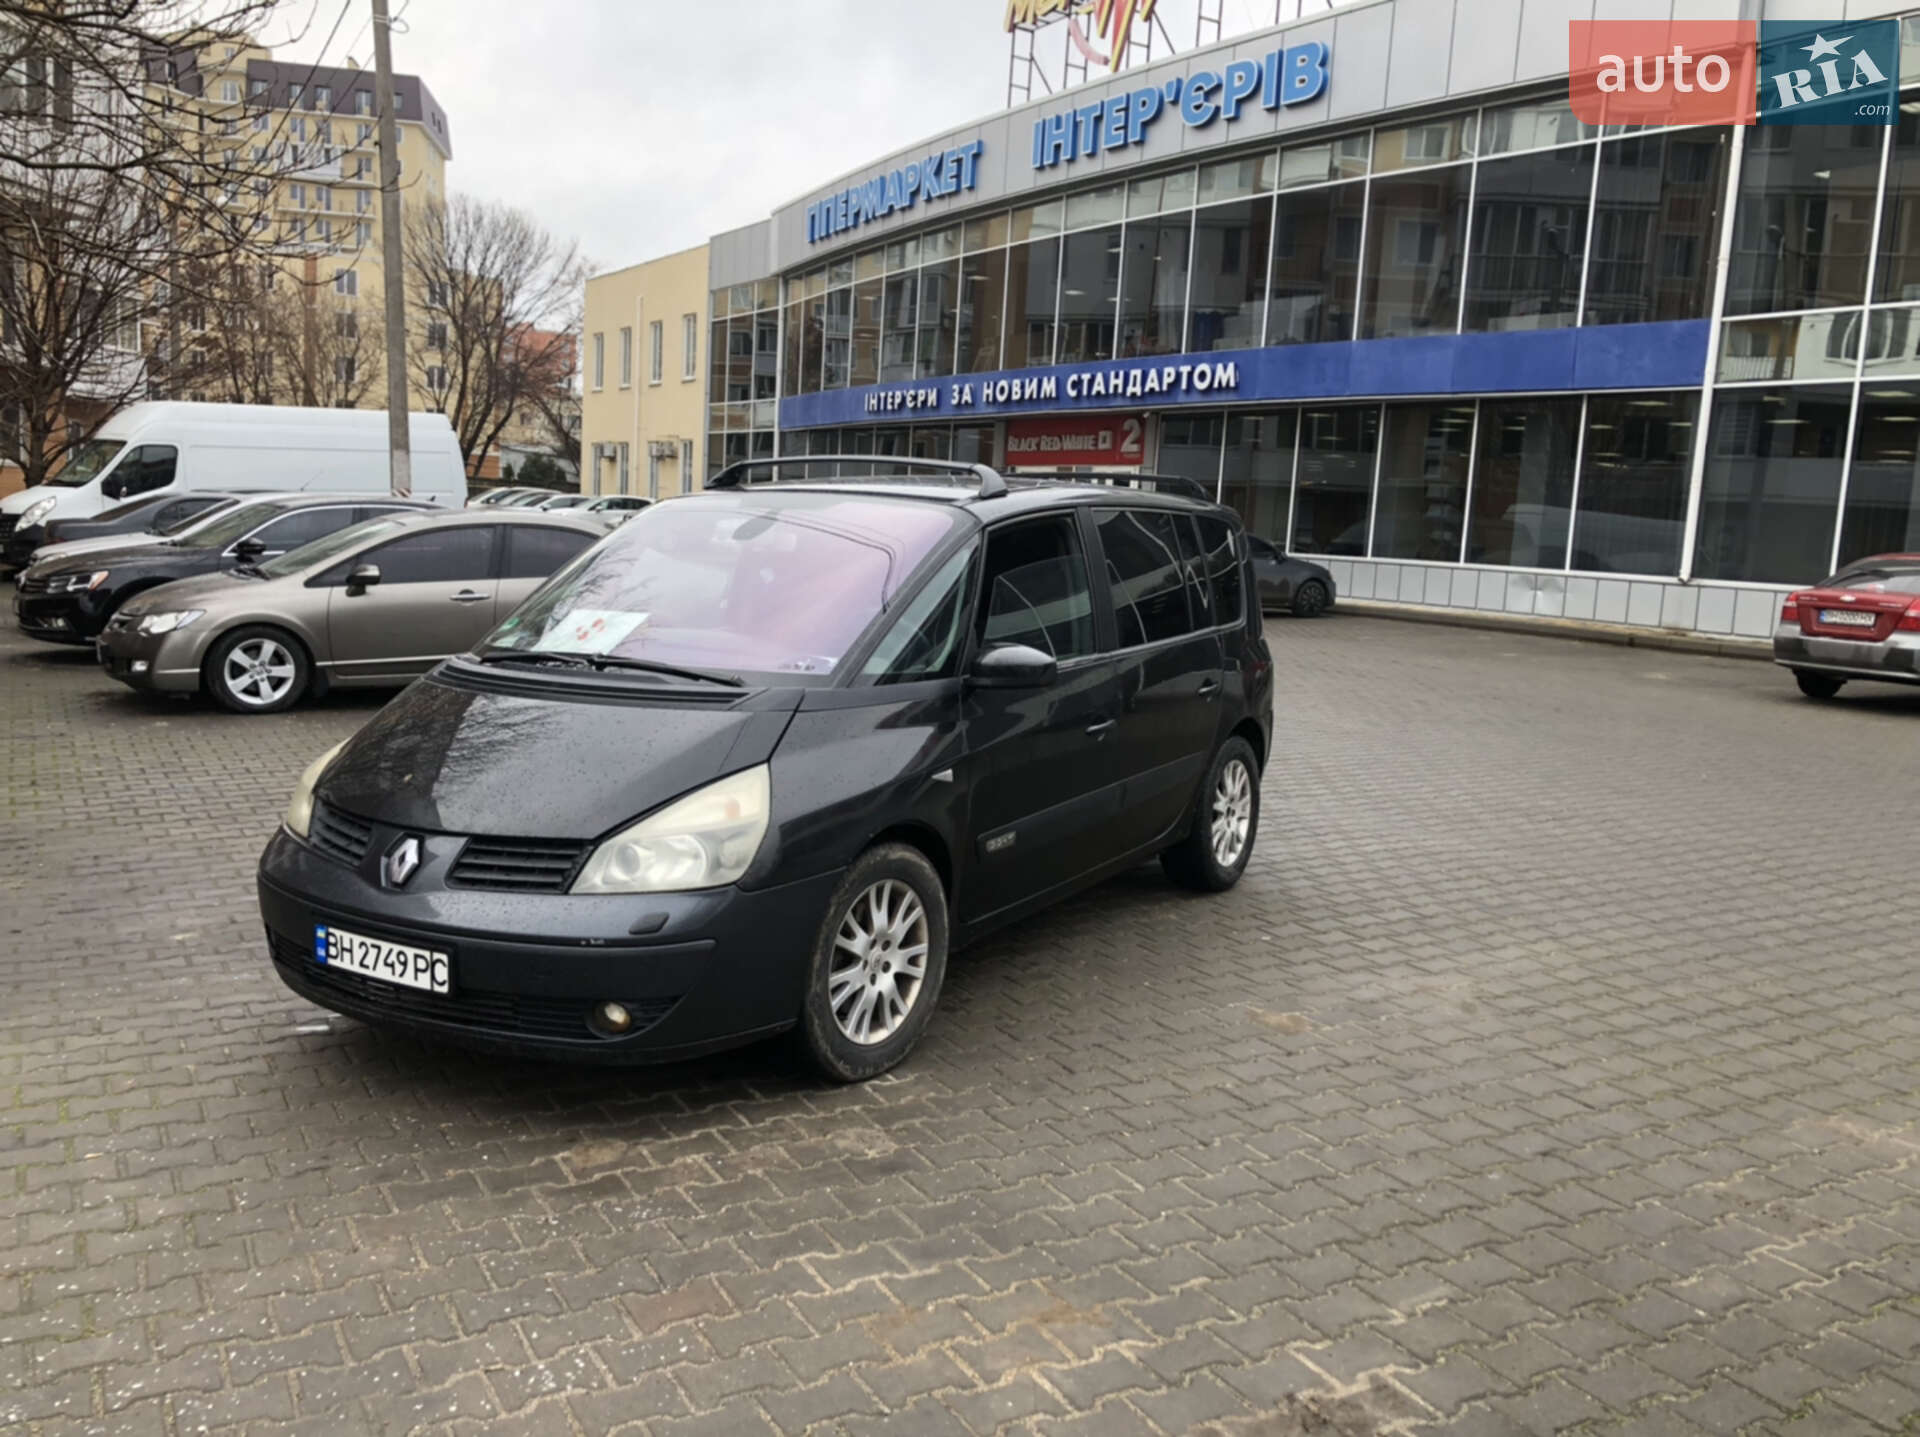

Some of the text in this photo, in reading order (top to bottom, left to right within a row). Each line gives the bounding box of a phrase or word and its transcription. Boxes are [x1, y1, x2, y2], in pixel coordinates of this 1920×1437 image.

[1031, 40, 1330, 169] ІНТЕР'ЄРІВ
[864, 361, 1237, 412] ІНТЕР'ЄРИ ЗА НОВИМ СТАНДАРТОМ
[1120, 418, 1142, 453] 2
[326, 931, 448, 987] BH 2749 PC
